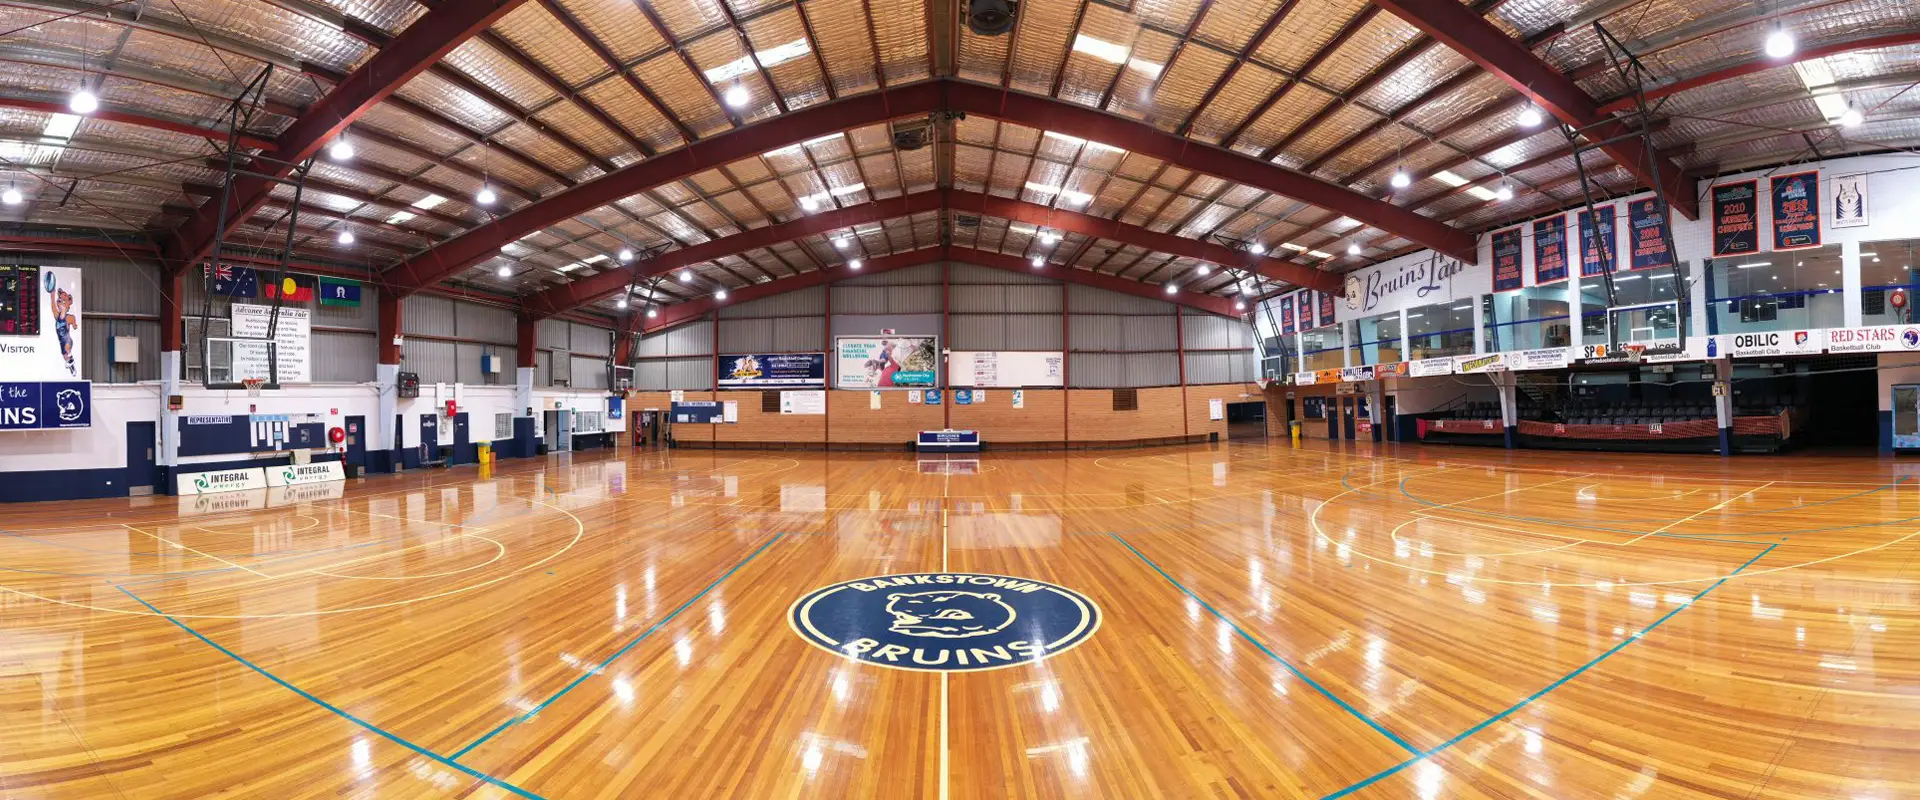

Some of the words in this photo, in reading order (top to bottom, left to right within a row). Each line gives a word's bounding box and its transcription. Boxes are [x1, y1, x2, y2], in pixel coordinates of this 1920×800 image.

[1589, 236, 1606, 248] 25
[1362, 264, 1425, 312] Bruins
[234, 306, 263, 315] Advance
[263, 308, 294, 317] Auralia
[1735, 333, 1779, 348] OBILIC
[1831, 330, 1854, 342] RED
[1856, 328, 1895, 341] STARS
[8, 386, 28, 398] the
[189, 416, 232, 424] REPRESENTATIVE
[297, 465, 330, 475] INTEGRAL
[211, 472, 249, 483] INTEGRAL
[213, 481, 246, 489] energy
[847, 574, 1048, 594] BANKSTOWN
[849, 637, 1042, 666] BRUINS
